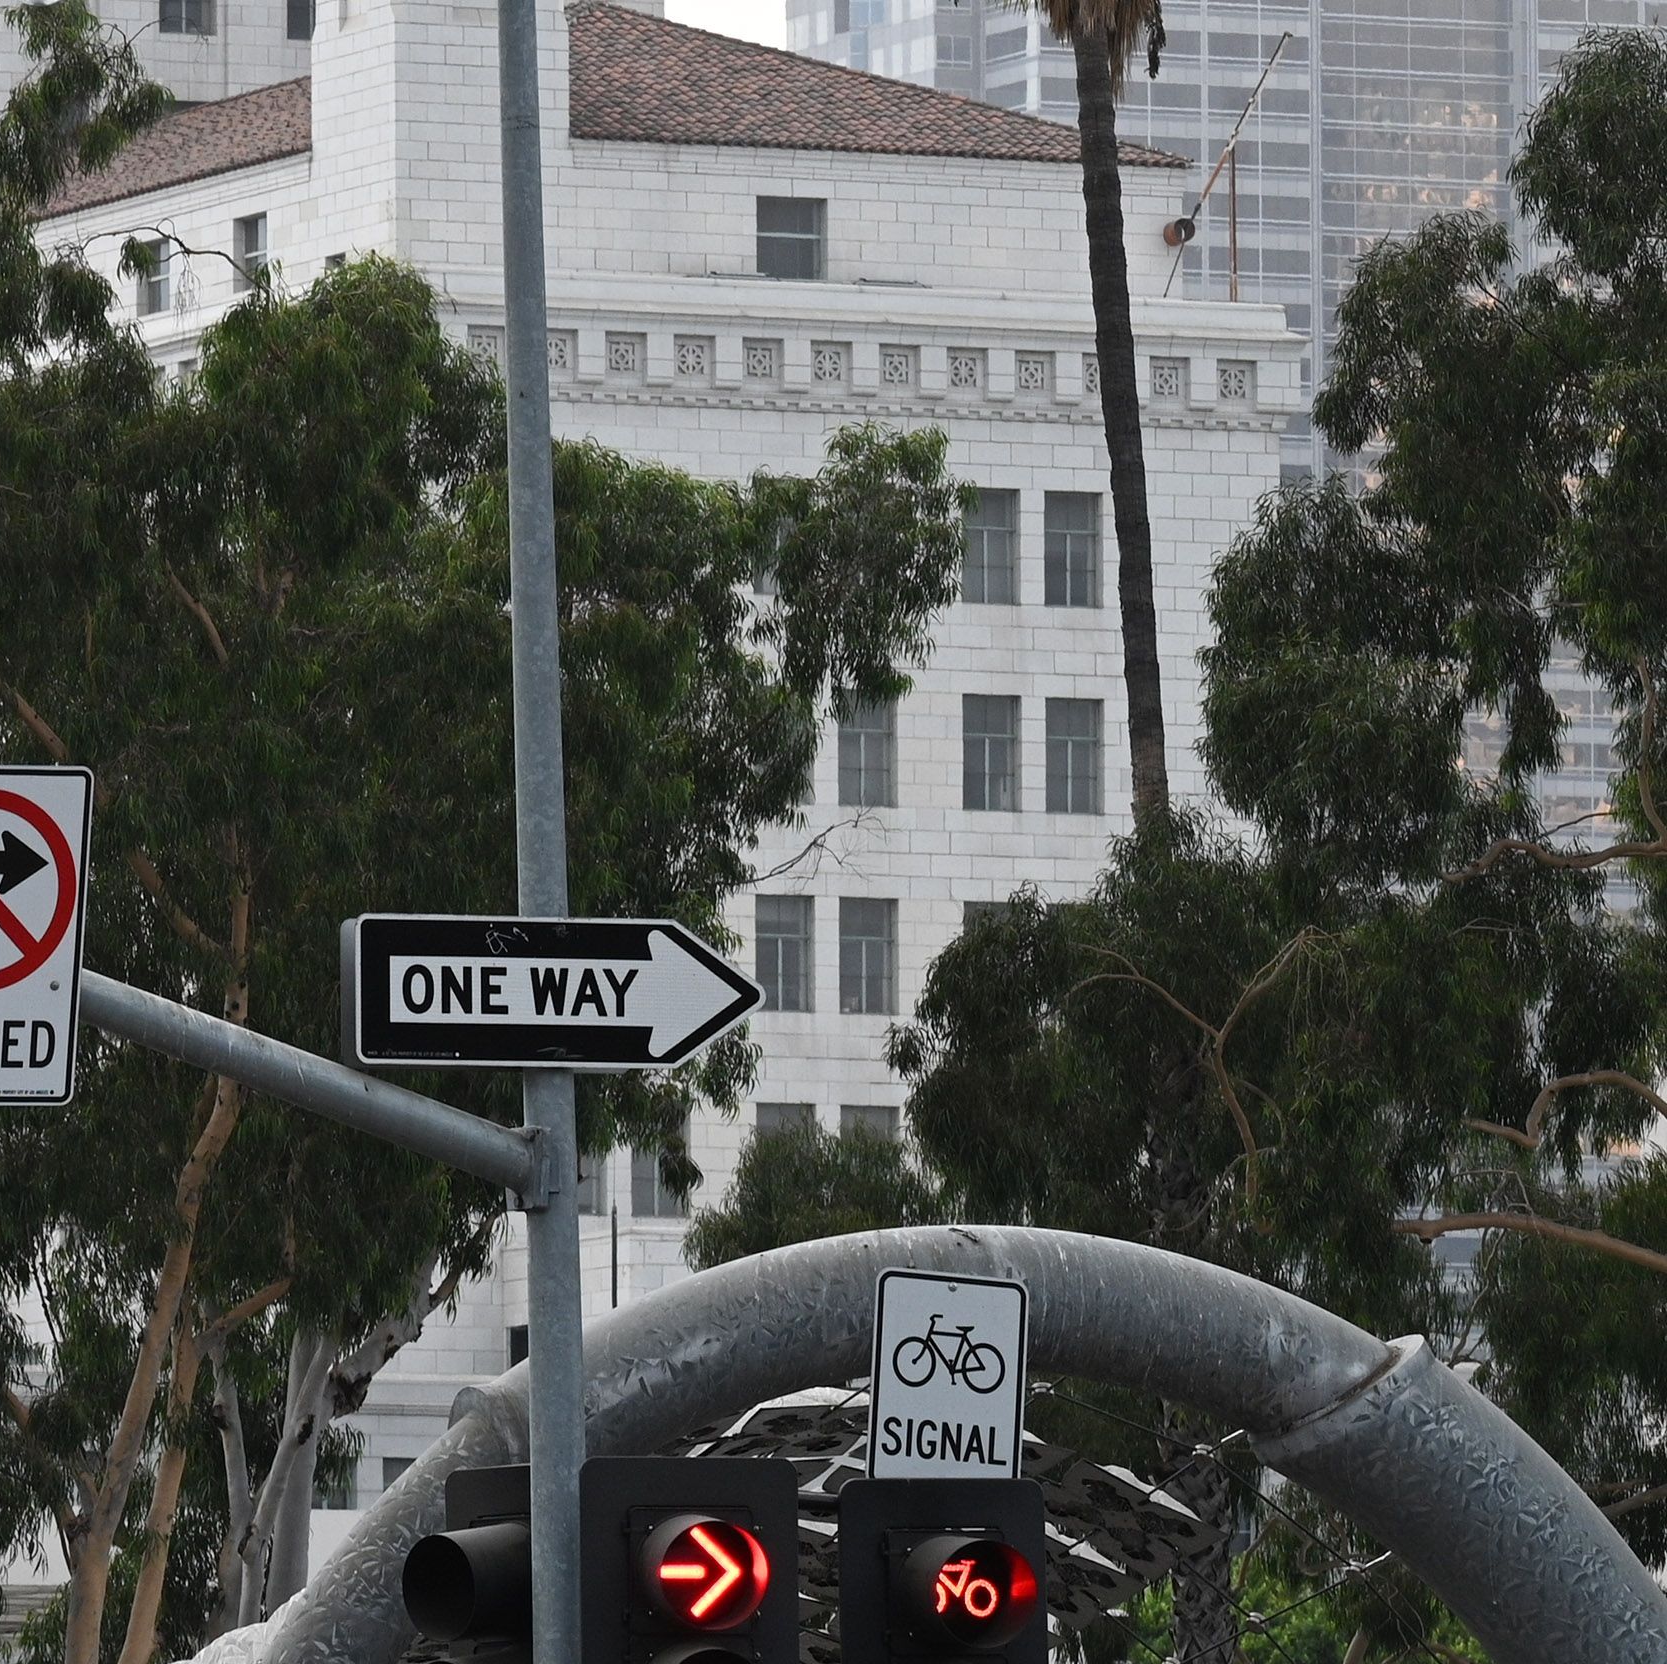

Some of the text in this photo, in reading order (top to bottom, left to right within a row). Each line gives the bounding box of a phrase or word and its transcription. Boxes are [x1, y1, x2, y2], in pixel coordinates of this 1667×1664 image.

[402, 963, 639, 1018] ONE WAY
[881, 1416, 1007, 1466] SIGNAL
